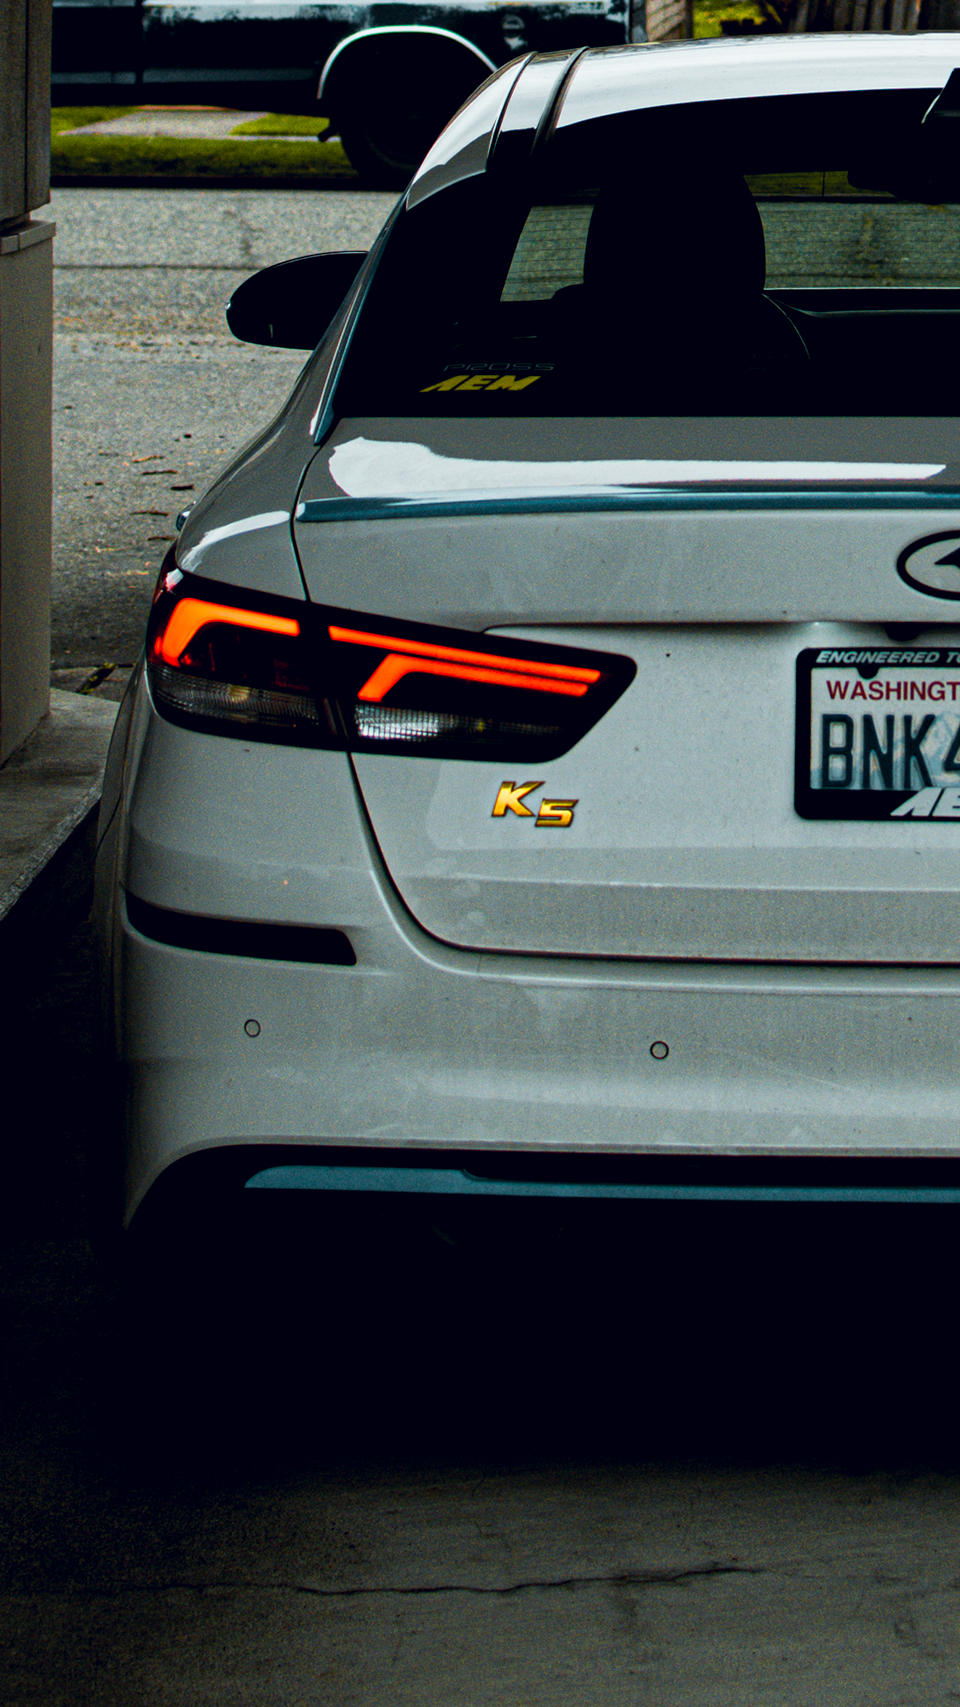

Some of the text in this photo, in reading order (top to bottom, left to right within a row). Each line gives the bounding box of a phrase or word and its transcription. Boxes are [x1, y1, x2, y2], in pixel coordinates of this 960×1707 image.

[419, 374, 542, 393] AEM
[816, 650, 941, 664] ENGINEERED
[491, 781, 579, 827] K5
